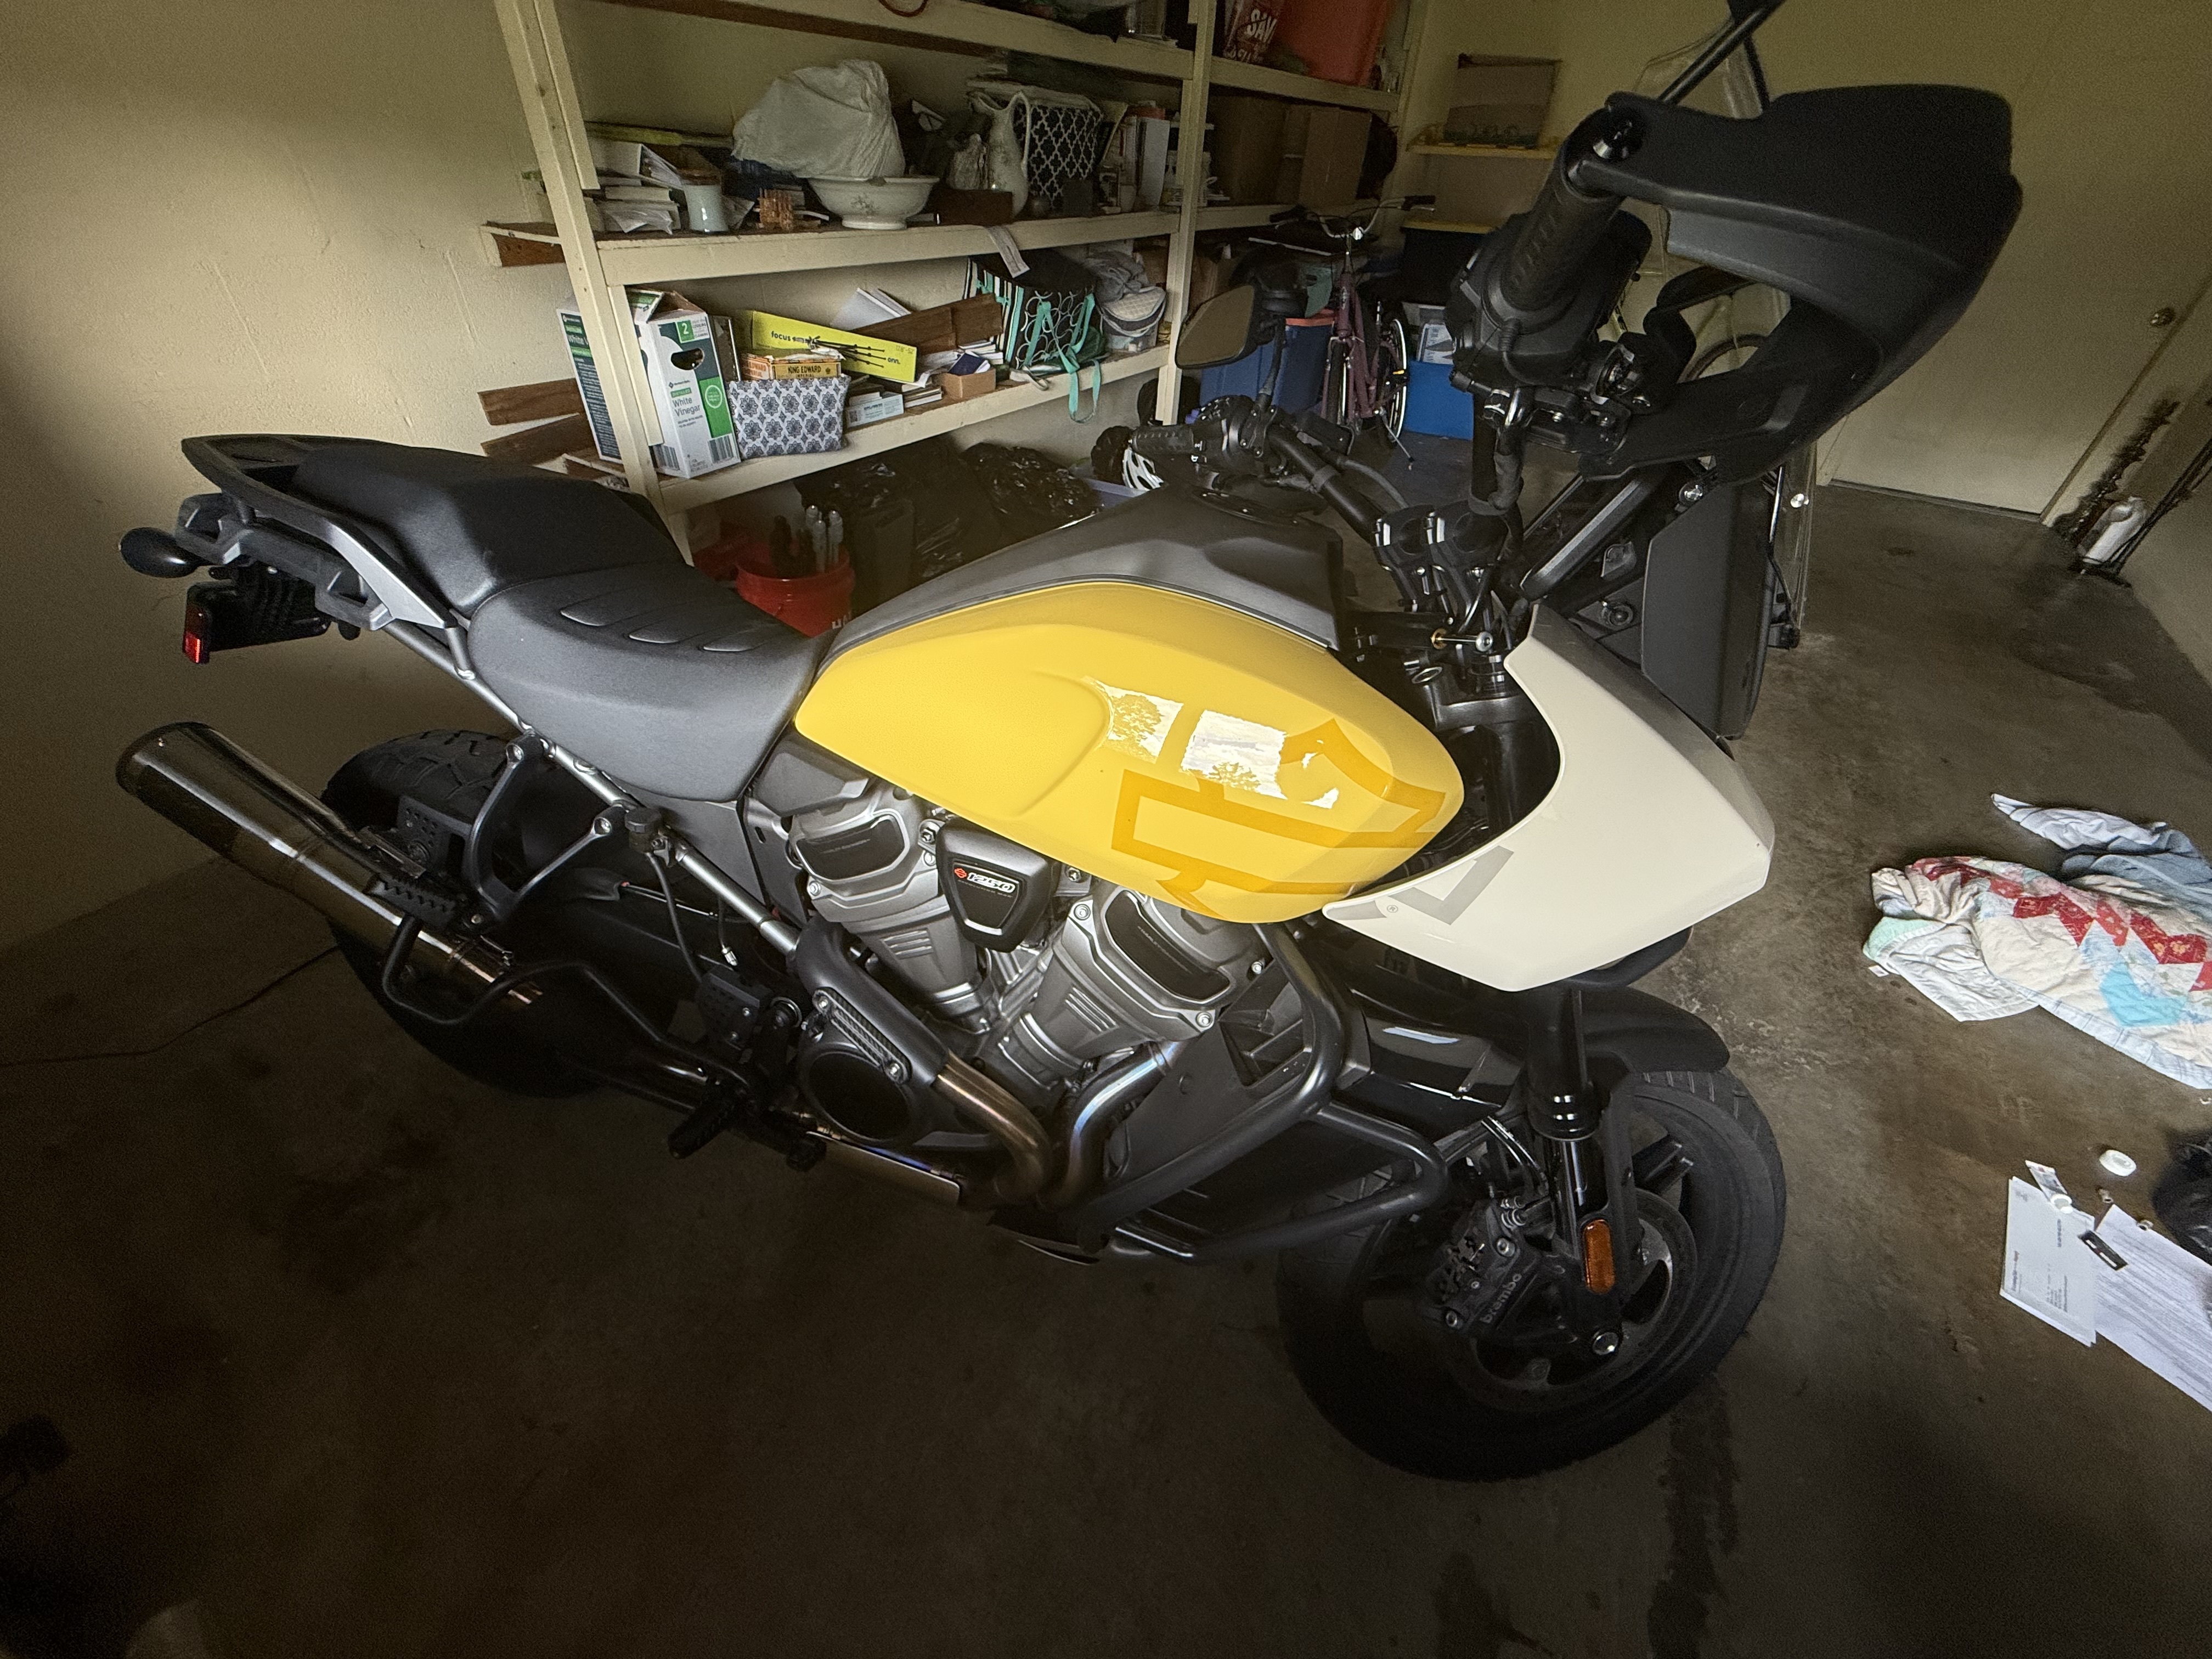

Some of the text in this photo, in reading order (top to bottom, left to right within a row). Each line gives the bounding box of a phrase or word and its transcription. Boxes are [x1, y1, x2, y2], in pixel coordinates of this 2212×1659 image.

[681, 323, 690, 335] 2
[771, 330, 791, 341] focus
[800, 365, 821, 374] EDWARD
[672, 397, 692, 408] White
[674, 404, 701, 417] Vinegar
[967, 872, 1016, 893] 1250
[1479, 1273, 1522, 1323] brembo
